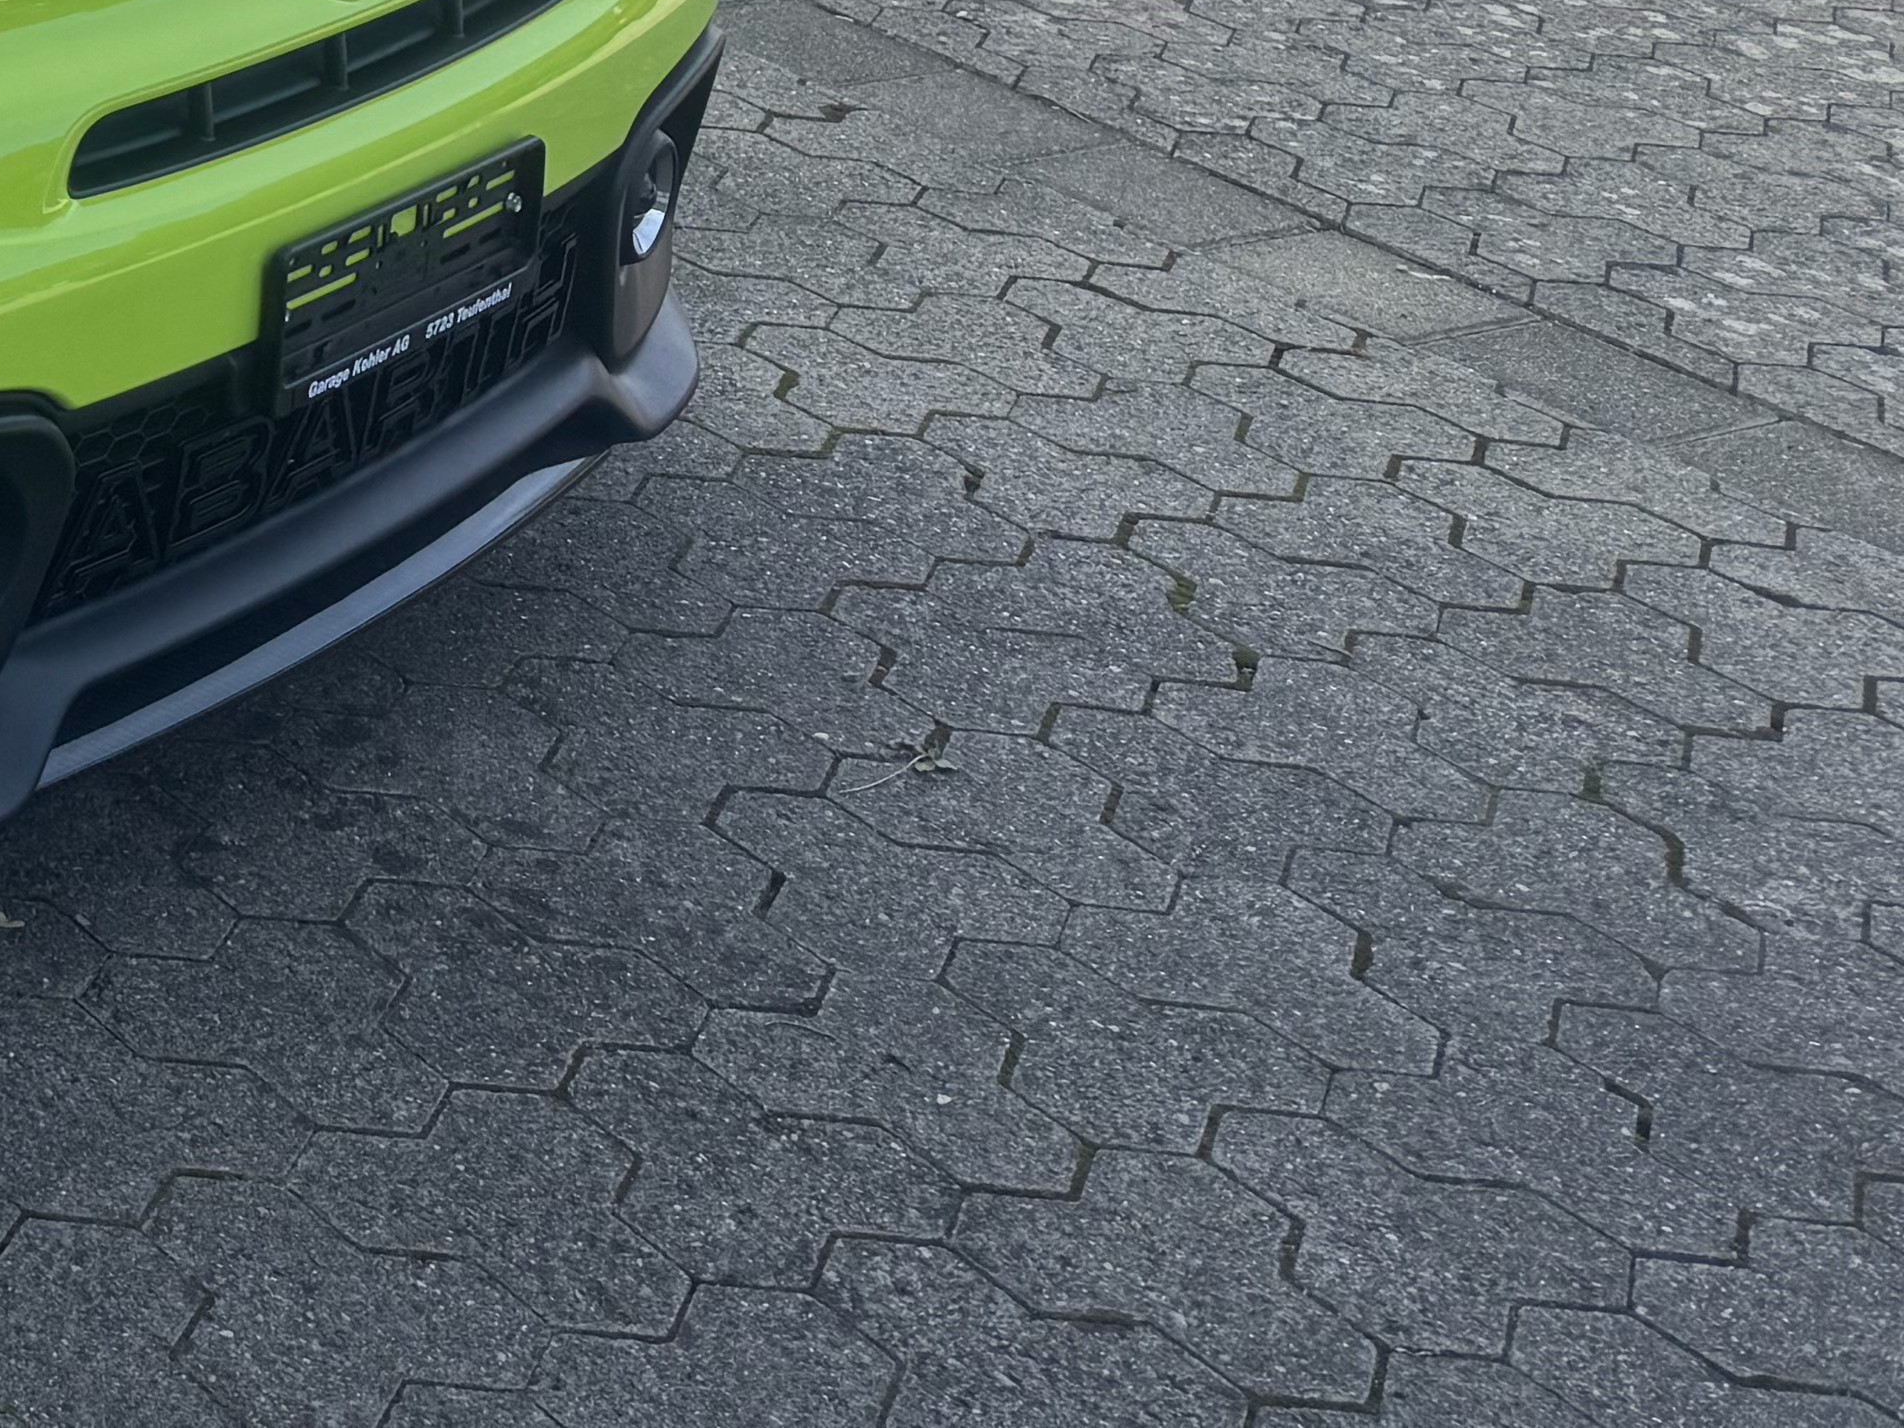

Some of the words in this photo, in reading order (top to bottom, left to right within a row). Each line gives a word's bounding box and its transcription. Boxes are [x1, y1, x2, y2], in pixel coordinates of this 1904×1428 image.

[308, 367, 350, 399] Garage
[352, 346, 391, 377] Kohler
[392, 334, 411, 357] AG
[425, 312, 455, 339] 5723
[456, 282, 513, 323] Teufenthal
